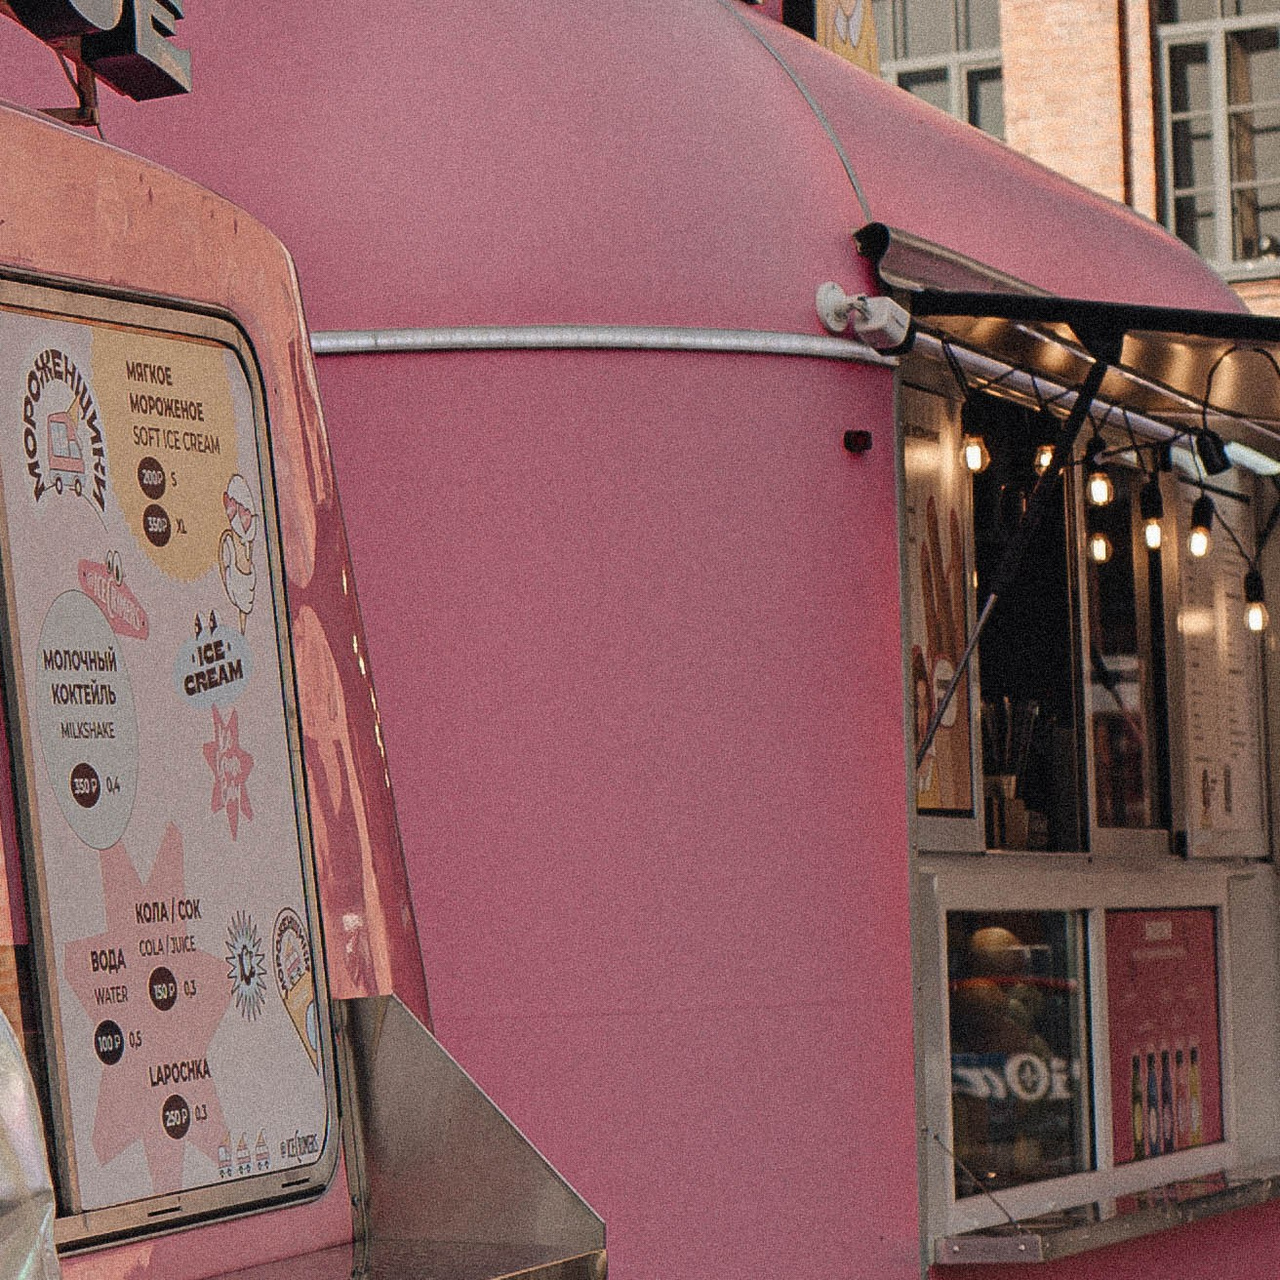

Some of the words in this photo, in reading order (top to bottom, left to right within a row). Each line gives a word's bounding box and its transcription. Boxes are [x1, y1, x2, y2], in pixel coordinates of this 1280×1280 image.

[126, 360, 173, 386] МЯГКОЕ
[129, 392, 205, 422] МОРОЖЕНОЕ
[133, 425, 160, 448] SOFT
[163, 429, 181, 450] ICE
[183, 431, 221, 455] CREAM
[171, 471, 178, 487] S
[42, 645, 118, 672] МОЛОЧНЫЙ
[196, 639, 226, 667] ICE
[184, 659, 244, 696] CREAM
[51, 678, 117, 705] КОКТЕЙЛЬ
[60, 721, 116, 739] MILKSHAKE
[135, 901, 169, 924] КОЛА
[178, 898, 202, 920] СОК
[90, 947, 127, 974] ВОДА
[94, 985, 128, 1005] WATER
[148, 1057, 212, 1087] LAPOCHKA
